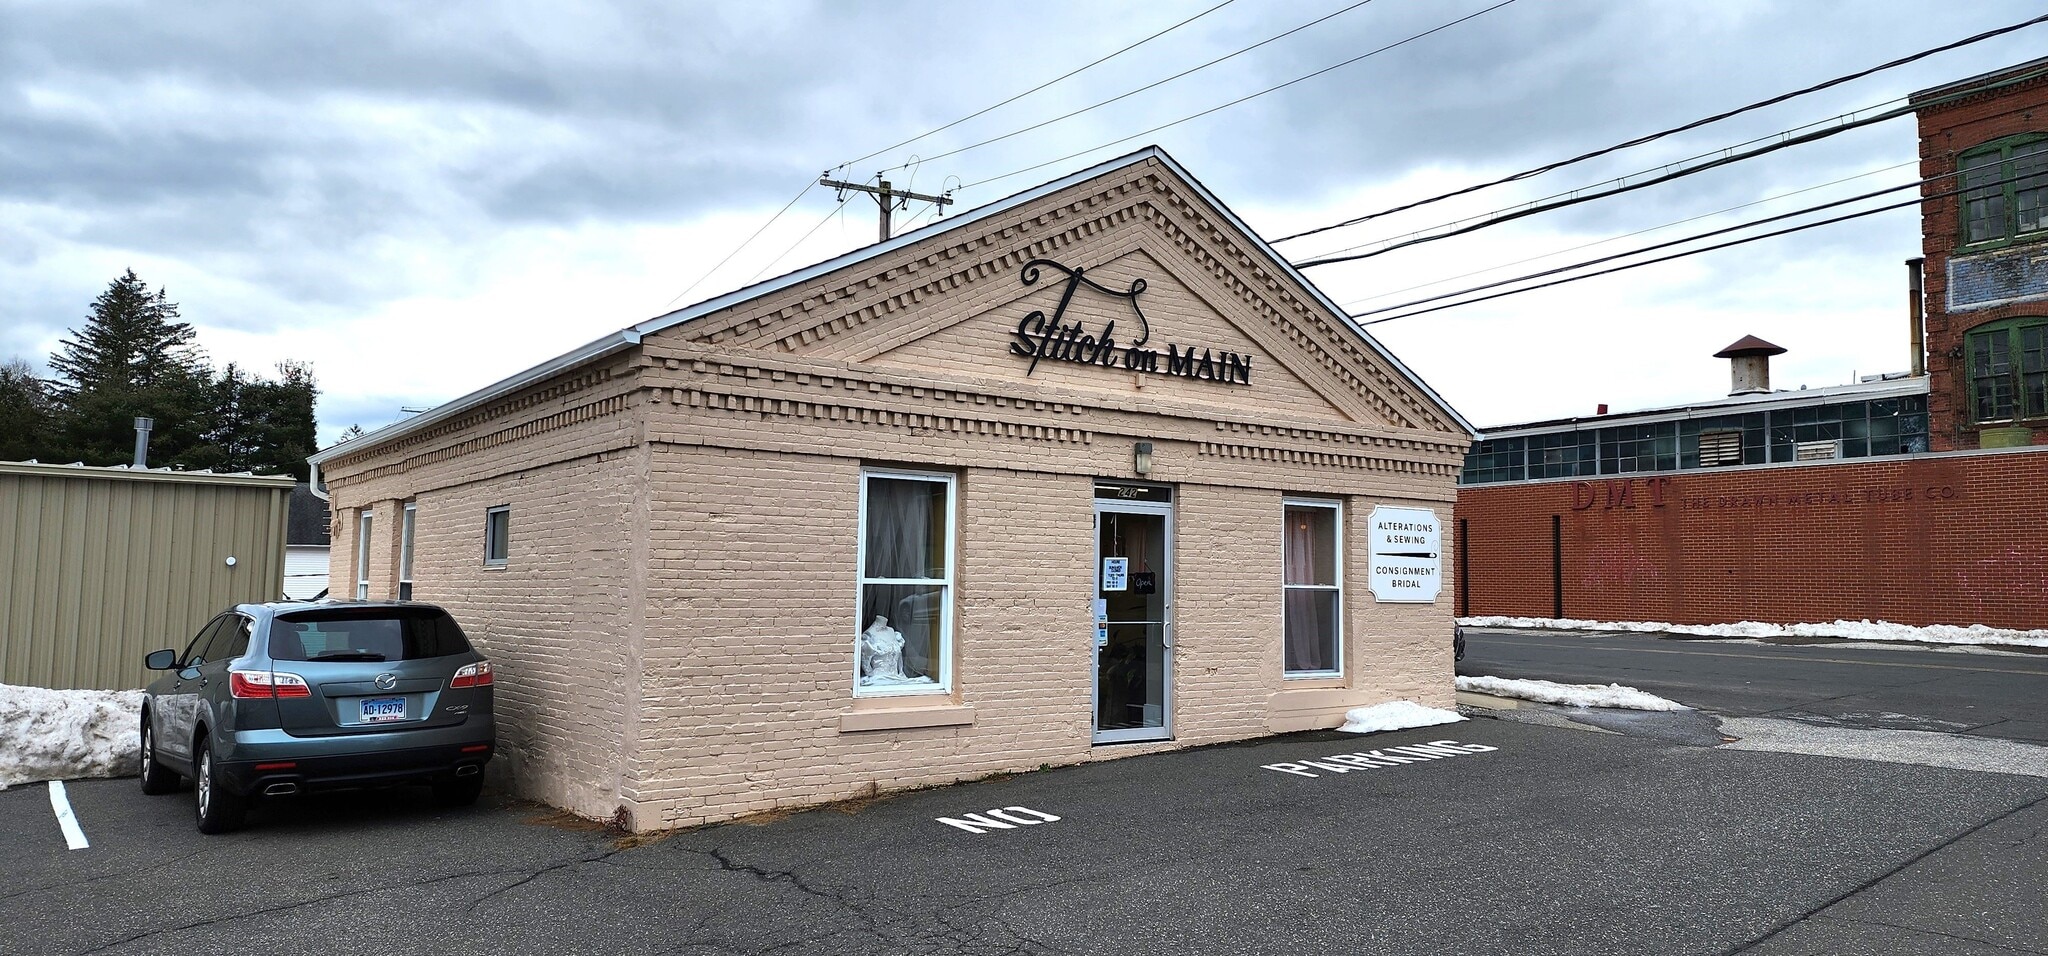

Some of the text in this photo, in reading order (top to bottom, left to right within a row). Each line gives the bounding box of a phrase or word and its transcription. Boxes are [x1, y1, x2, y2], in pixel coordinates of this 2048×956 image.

[1010, 305, 1252, 385] Stitch on MAIN
[1117, 486, 1138, 499] 242
[1571, 476, 1670, 510] DMT
[1681, 486, 1960, 509] THE DRAWN METAL TUBE CO.
[1378, 521, 1433, 533] ALTERATIONS
[1386, 534, 1425, 545] & SEWING
[1376, 566, 1435, 576] CONSIGNMENT
[1135, 578, 1152, 589] Open
[1392, 579, 1421, 588] BRIDAL
[935, 740, 1498, 834] NO PARKING
